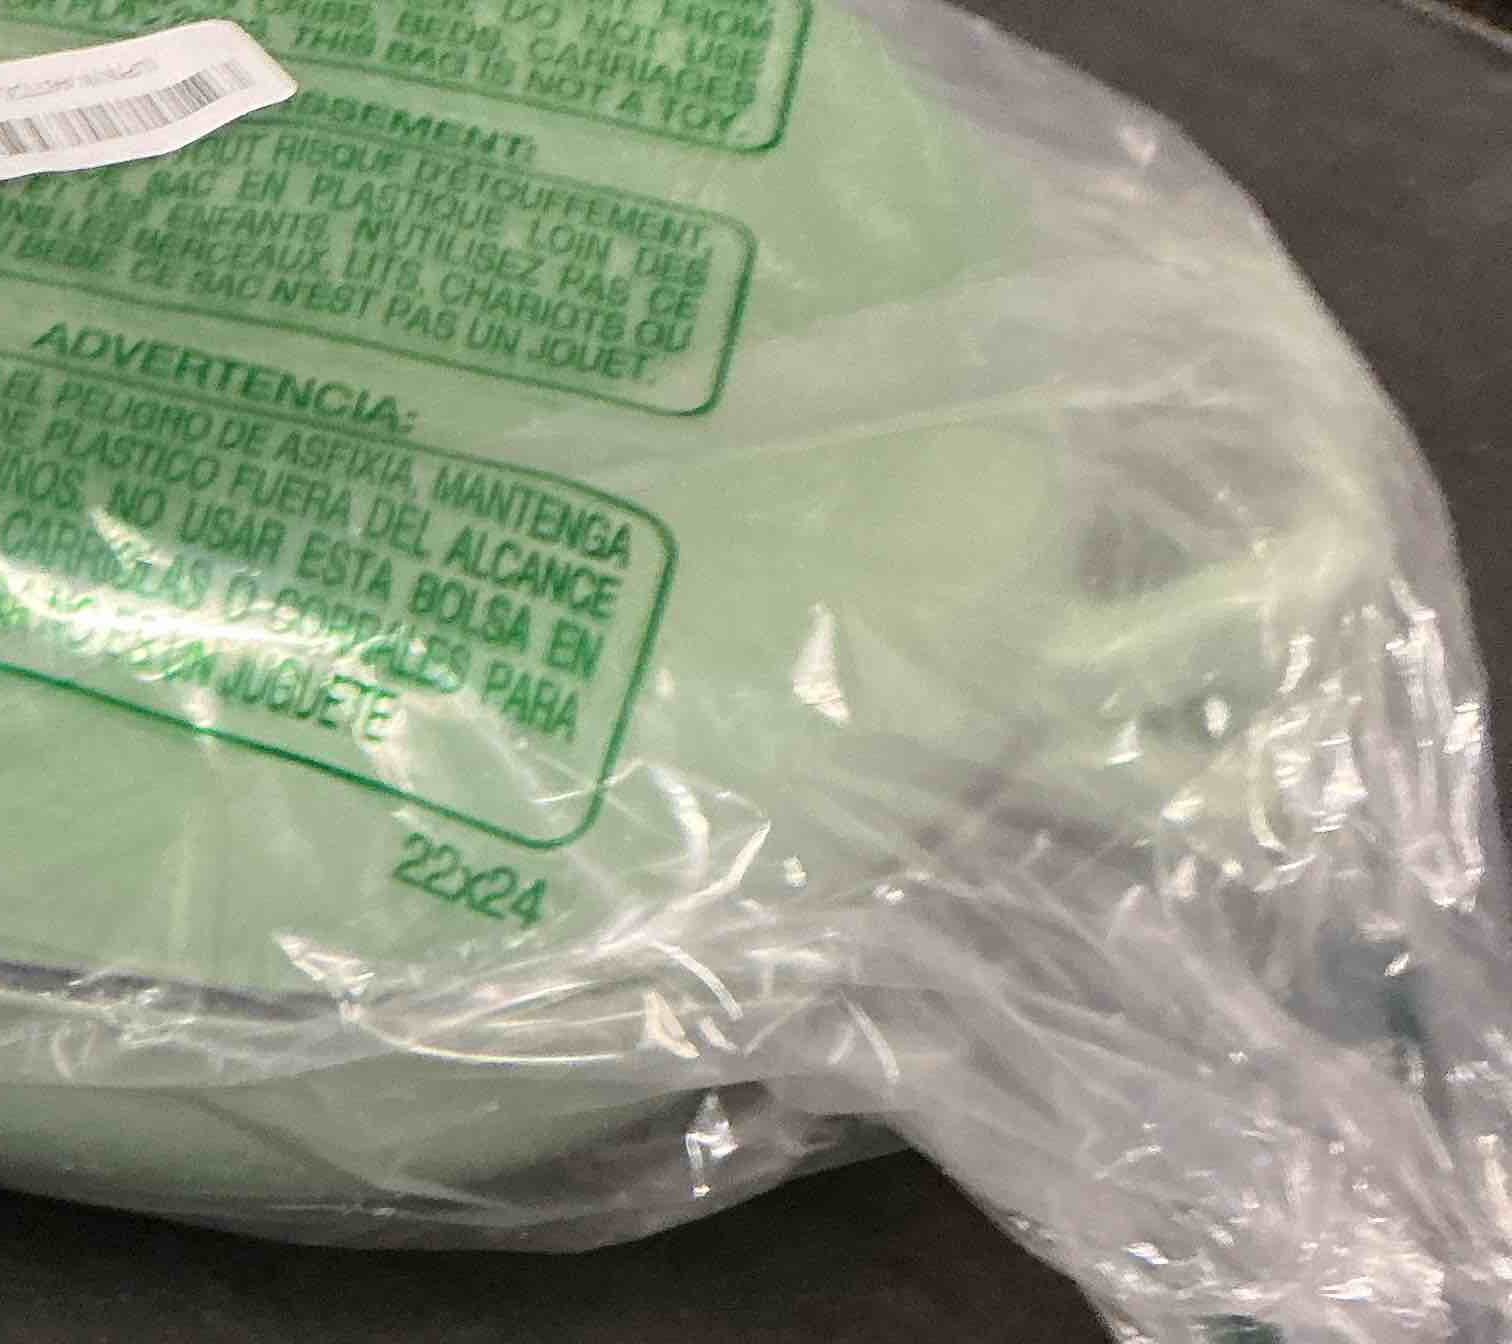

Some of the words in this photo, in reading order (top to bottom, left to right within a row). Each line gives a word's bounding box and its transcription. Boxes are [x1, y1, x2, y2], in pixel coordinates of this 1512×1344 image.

[386, 41, 468, 78] BAG
[527, 67, 610, 108] NOT
[616, 89, 642, 115] A
[528, 36, 757, 106] CARRIAGES
[582, 9, 659, 51] NOT
[274, 133, 404, 177] RISQUE
[238, 169, 289, 204] EN
[307, 173, 506, 237] PLASTIQUE
[529, 215, 614, 265] LOIN
[636, 247, 712, 288] DES
[352, 215, 544, 289] N'UTILISEZ
[558, 263, 630, 308] PAS
[648, 284, 700, 320] CE
[130, 258, 174, 290] CE
[189, 269, 264, 299] SAC
[270, 279, 377, 320] N'EST
[383, 293, 457, 343] PAS
[467, 315, 522, 356] UN
[439, 271, 627, 342] CHARIOTS
[637, 319, 692, 354] OU
[31, 321, 420, 434] ADVERTENCIA:
[3, 367, 40, 406] EL
[56, 380, 212, 443] PELIGRO
[218, 417, 277, 454] DE
[432, 464, 634, 569] MANTENGA
[42, 418, 222, 491] PLASTICO
[228, 460, 353, 529] FUERA
[365, 496, 431, 559] DEL
[442, 522, 625, 620] ALCANCE
[105, 478, 168, 530] NO
[178, 498, 288, 564] USAR
[295, 530, 394, 603] ESTA
[408, 570, 533, 655] BOLSA
[546, 617, 607, 682] EN
[479, 658, 580, 745] PARA
[391, 830, 548, 931] 22x24
